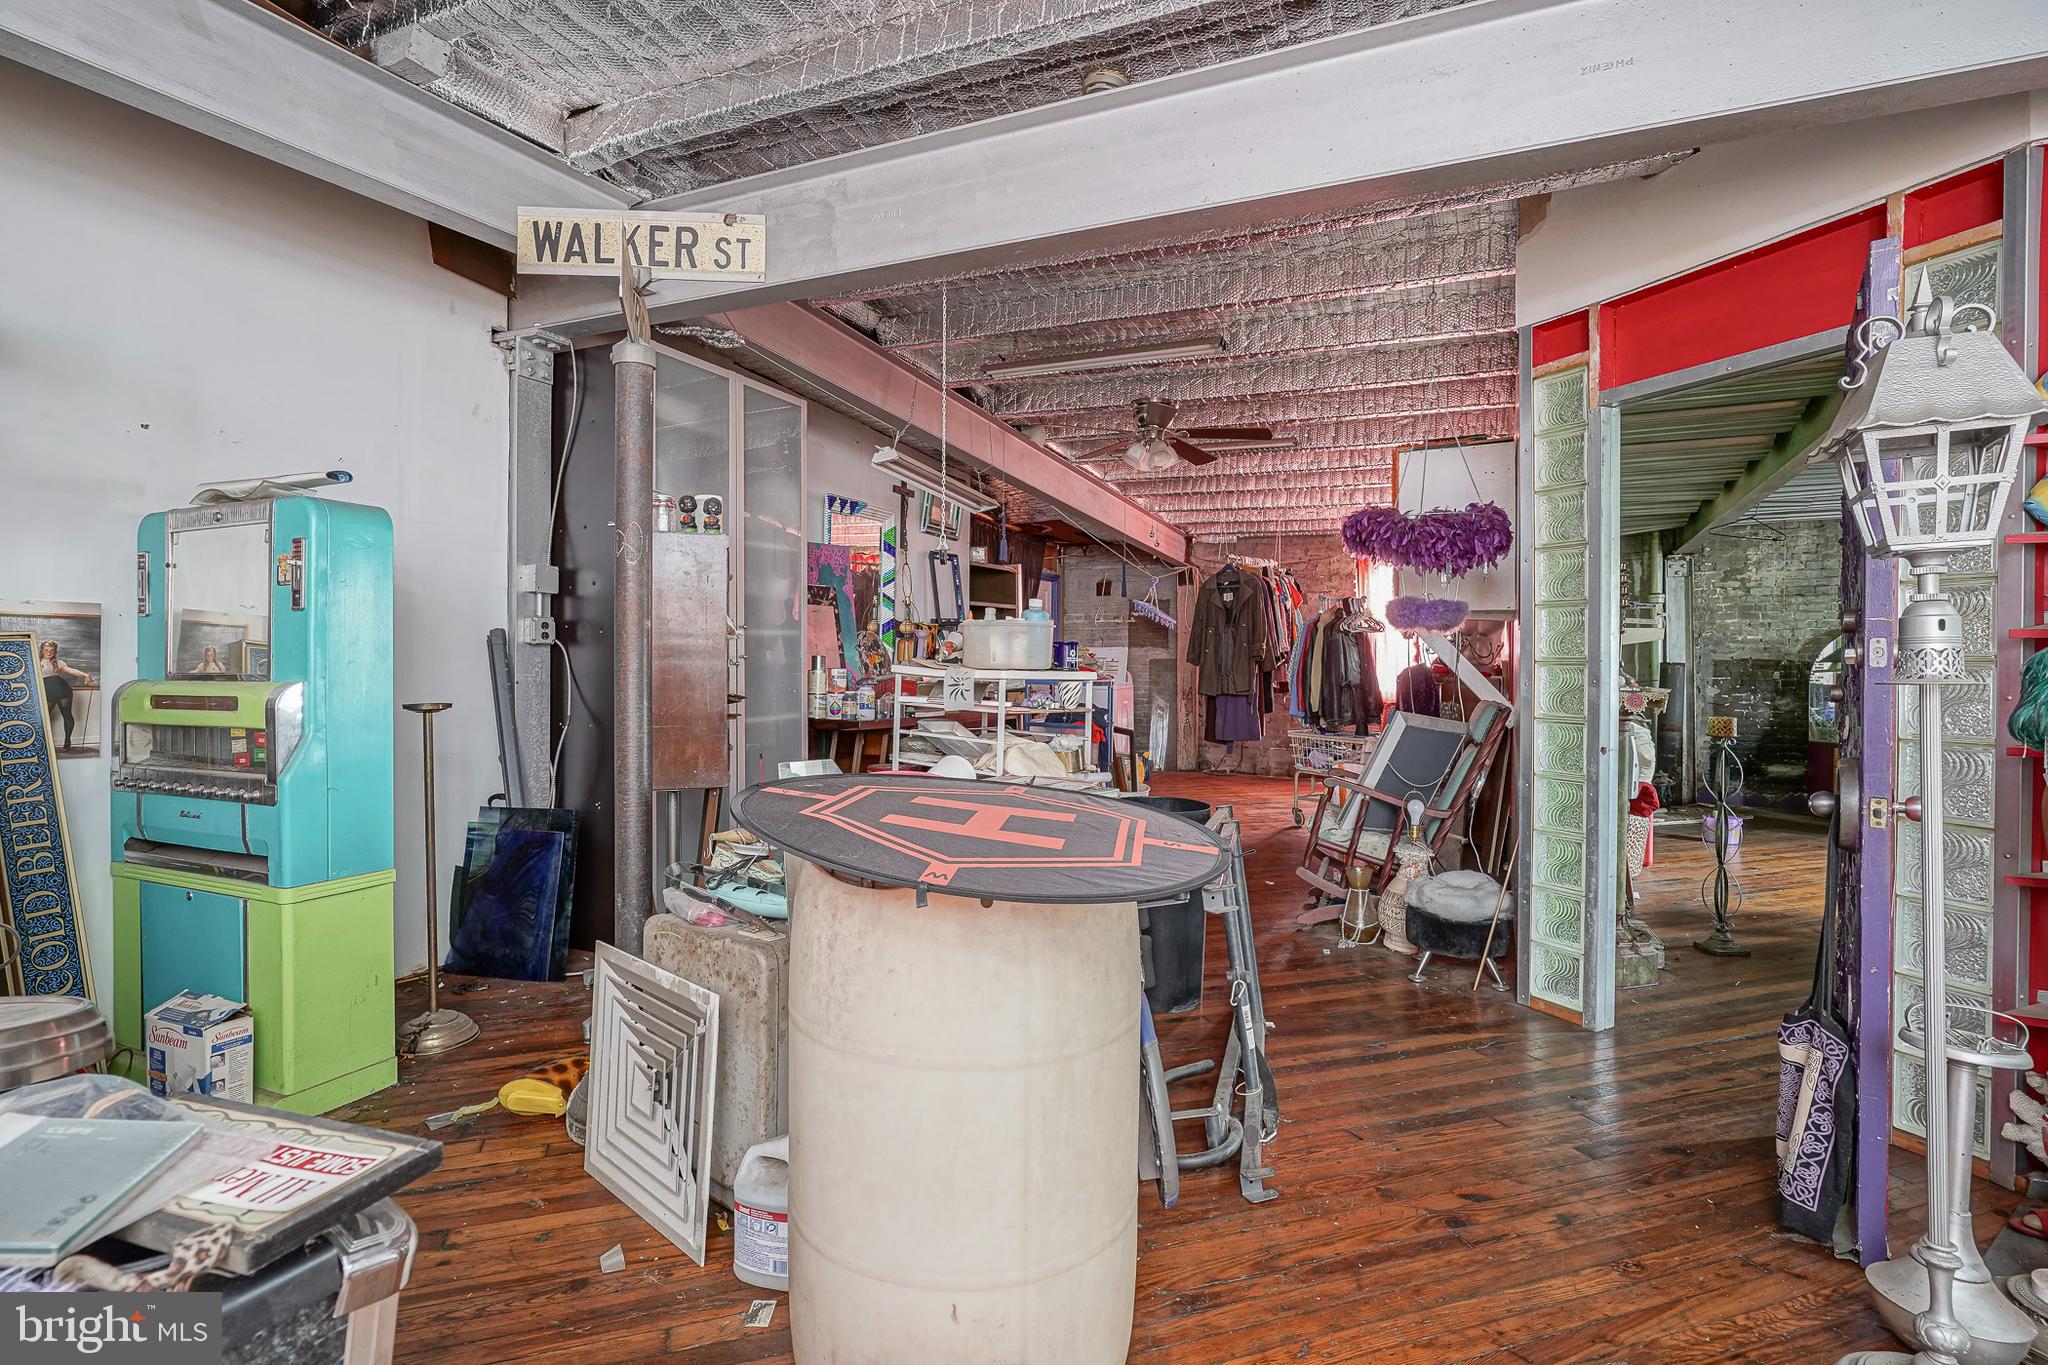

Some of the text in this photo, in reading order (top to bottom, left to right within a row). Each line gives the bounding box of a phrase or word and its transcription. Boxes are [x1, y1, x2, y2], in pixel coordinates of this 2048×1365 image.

[532, 220, 751, 270] WALKER ST
[0, 651, 75, 997] COLD BEER TO GO
[148, 1024, 188, 1050] Sunbeam
[211, 1027, 249, 1043] Sunbeam
[309, 1156, 371, 1175] SOME
